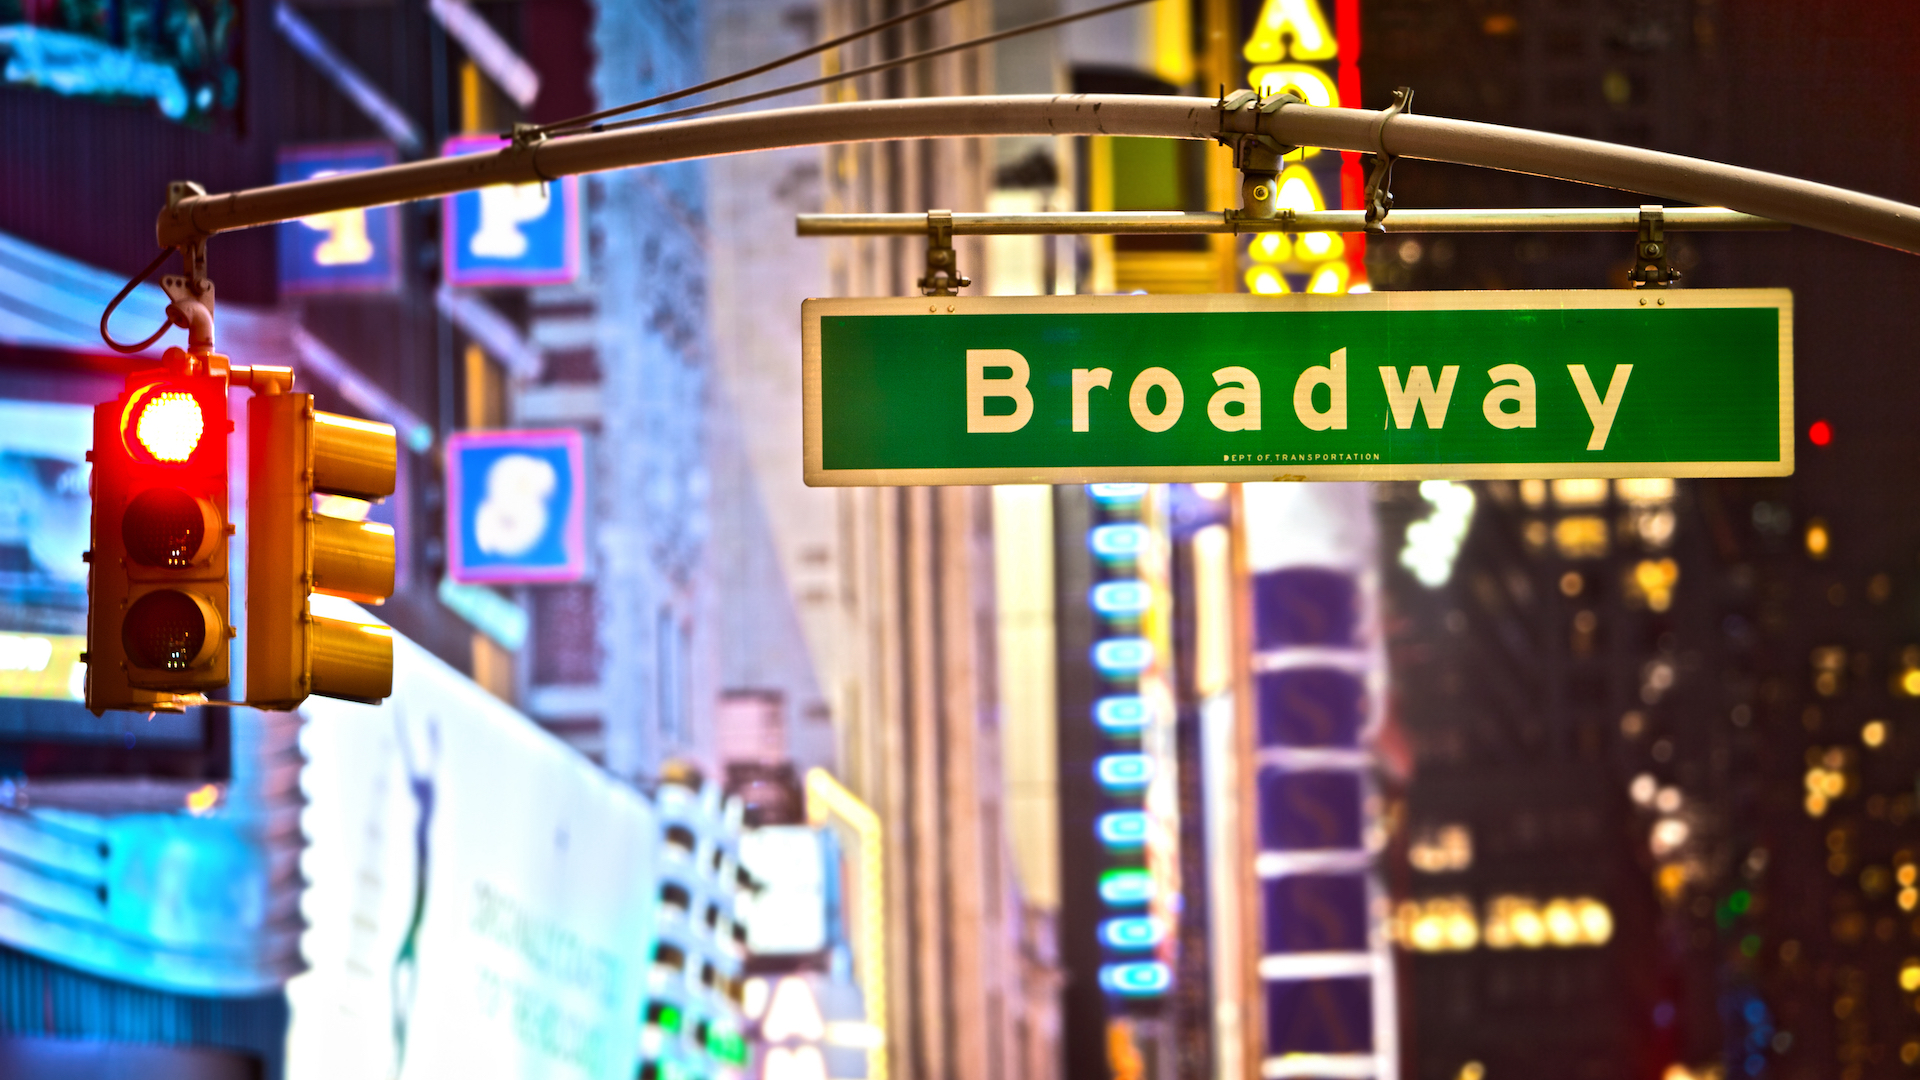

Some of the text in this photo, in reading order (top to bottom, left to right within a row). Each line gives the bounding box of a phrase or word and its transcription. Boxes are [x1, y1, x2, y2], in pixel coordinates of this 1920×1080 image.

[966, 347, 1633, 451] Broadway
[1223, 454, 1252, 462] DEPT
[1275, 453, 1380, 461] TRANSPORTATION
